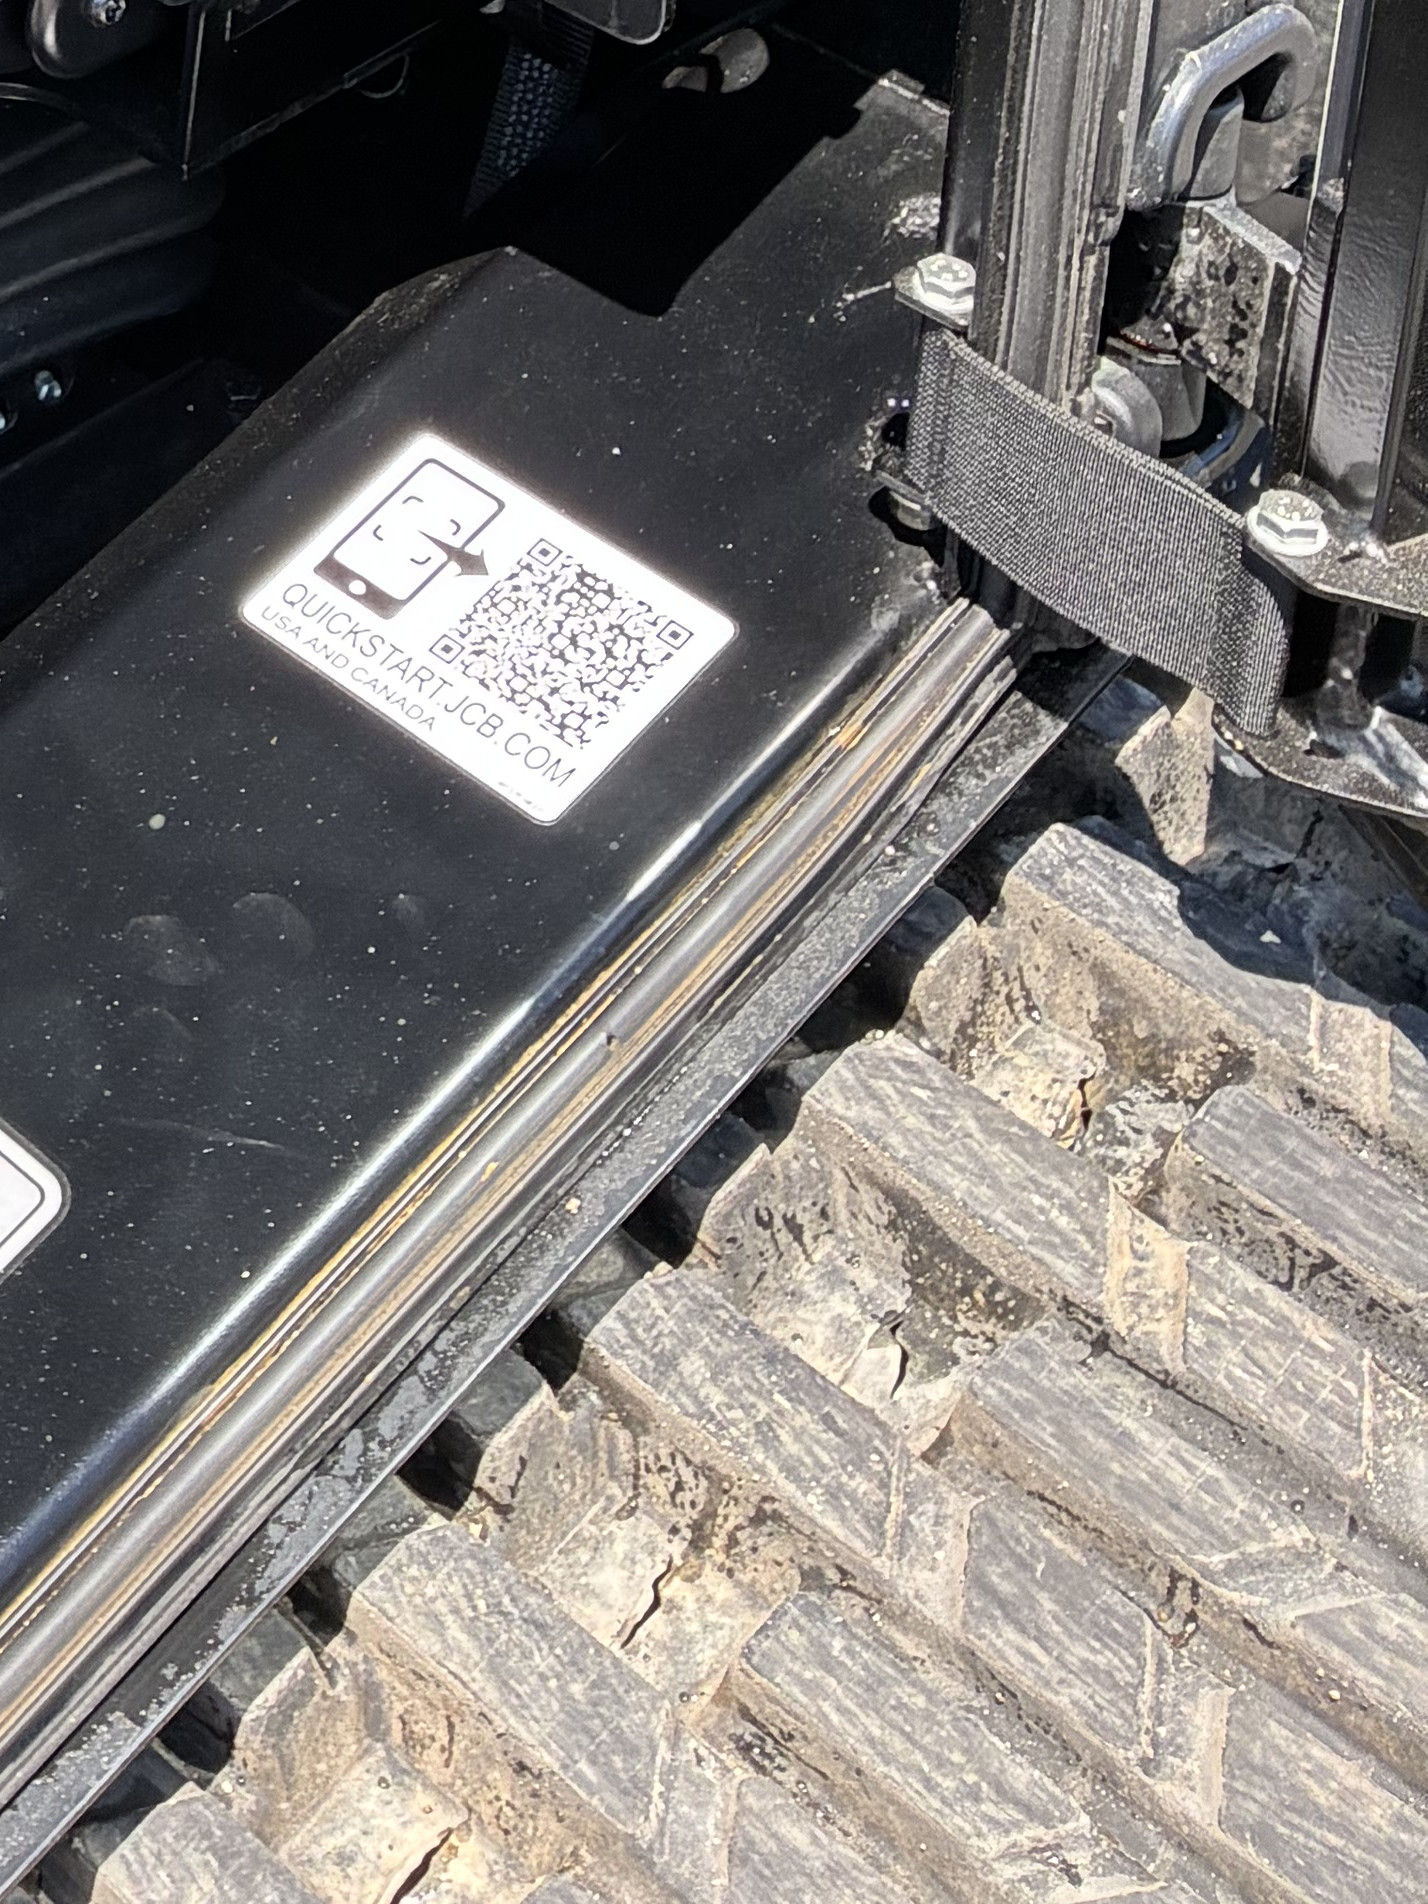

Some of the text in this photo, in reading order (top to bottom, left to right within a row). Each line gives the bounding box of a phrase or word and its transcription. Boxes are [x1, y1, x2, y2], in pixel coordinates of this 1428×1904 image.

[262, 606, 438, 732] USA AND CANADA
[282, 583, 577, 788] QUICKSTART.JCB.COM
